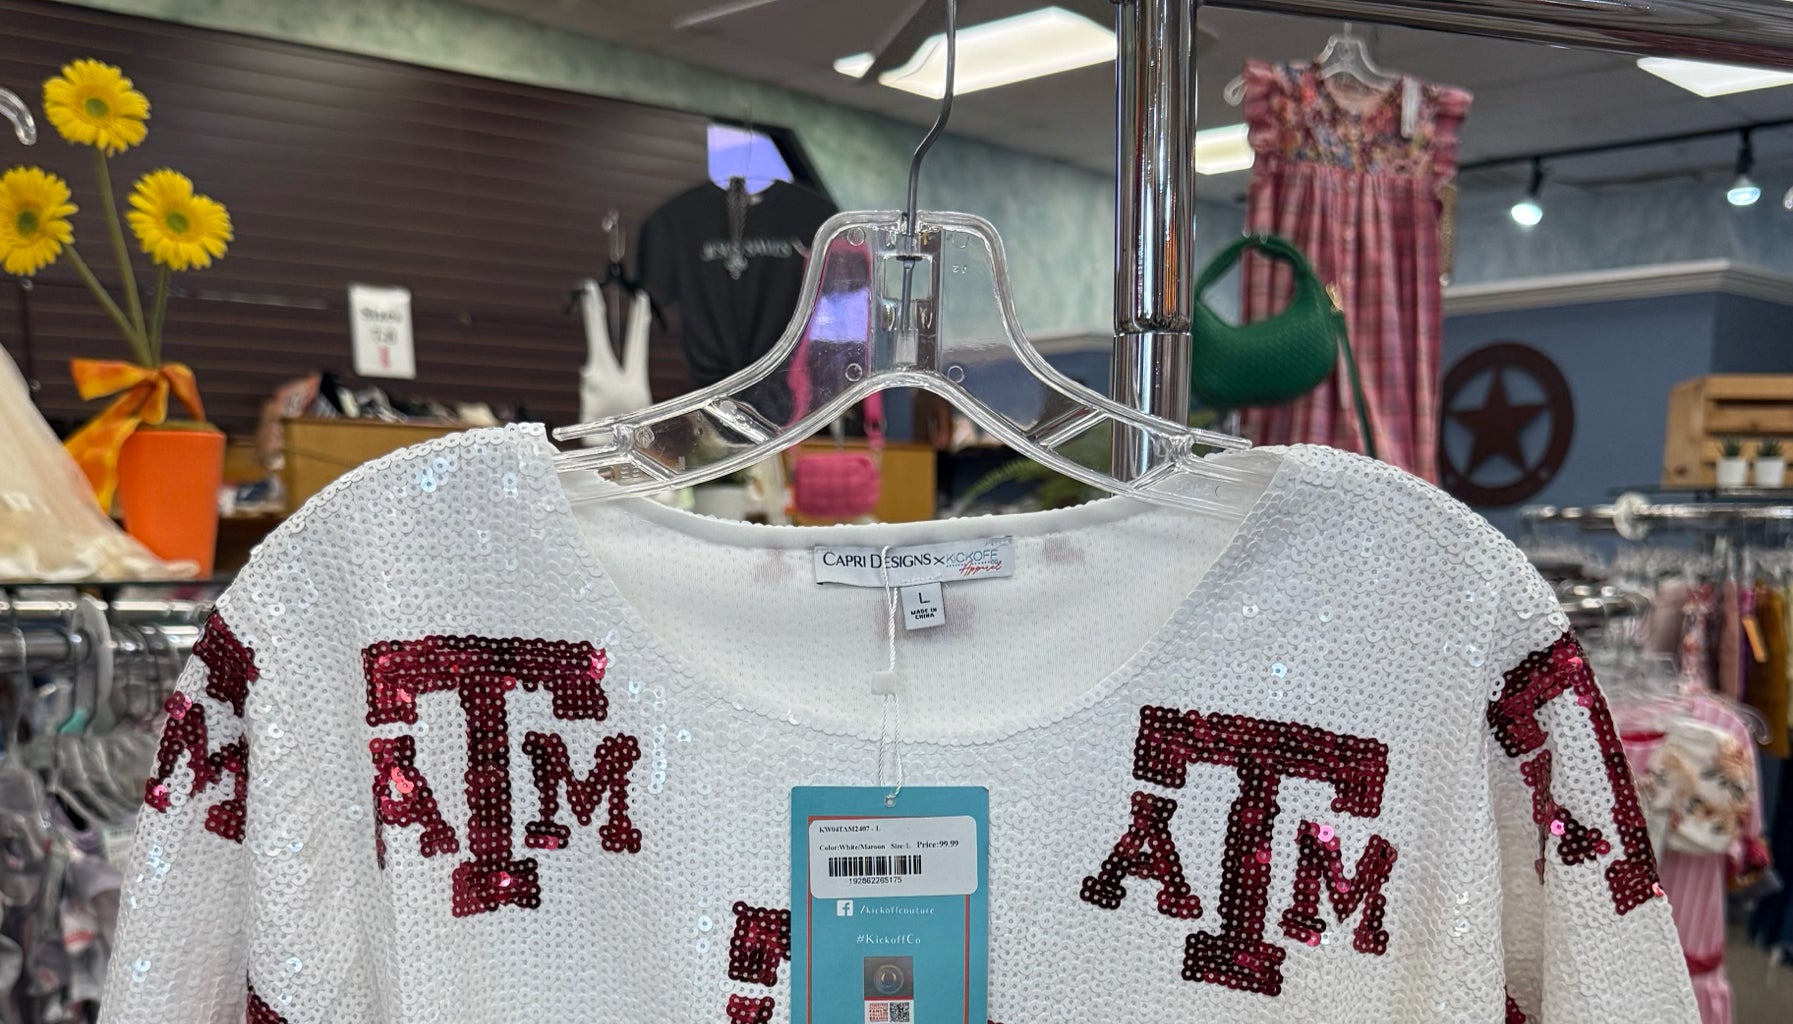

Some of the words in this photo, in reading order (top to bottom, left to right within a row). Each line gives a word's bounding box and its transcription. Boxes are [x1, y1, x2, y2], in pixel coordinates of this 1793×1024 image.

[822, 551, 867, 568] CAPRI
[870, 553, 932, 569] DESIGNS
[946, 549, 999, 564] KICKOFF
[959, 560, 1002, 577] Apparel
[918, 592, 930, 604] L
[914, 612, 935, 620] CHINA
[848, 876, 903, 885] 192862265175
[856, 933, 921, 945] #KickoffCo
